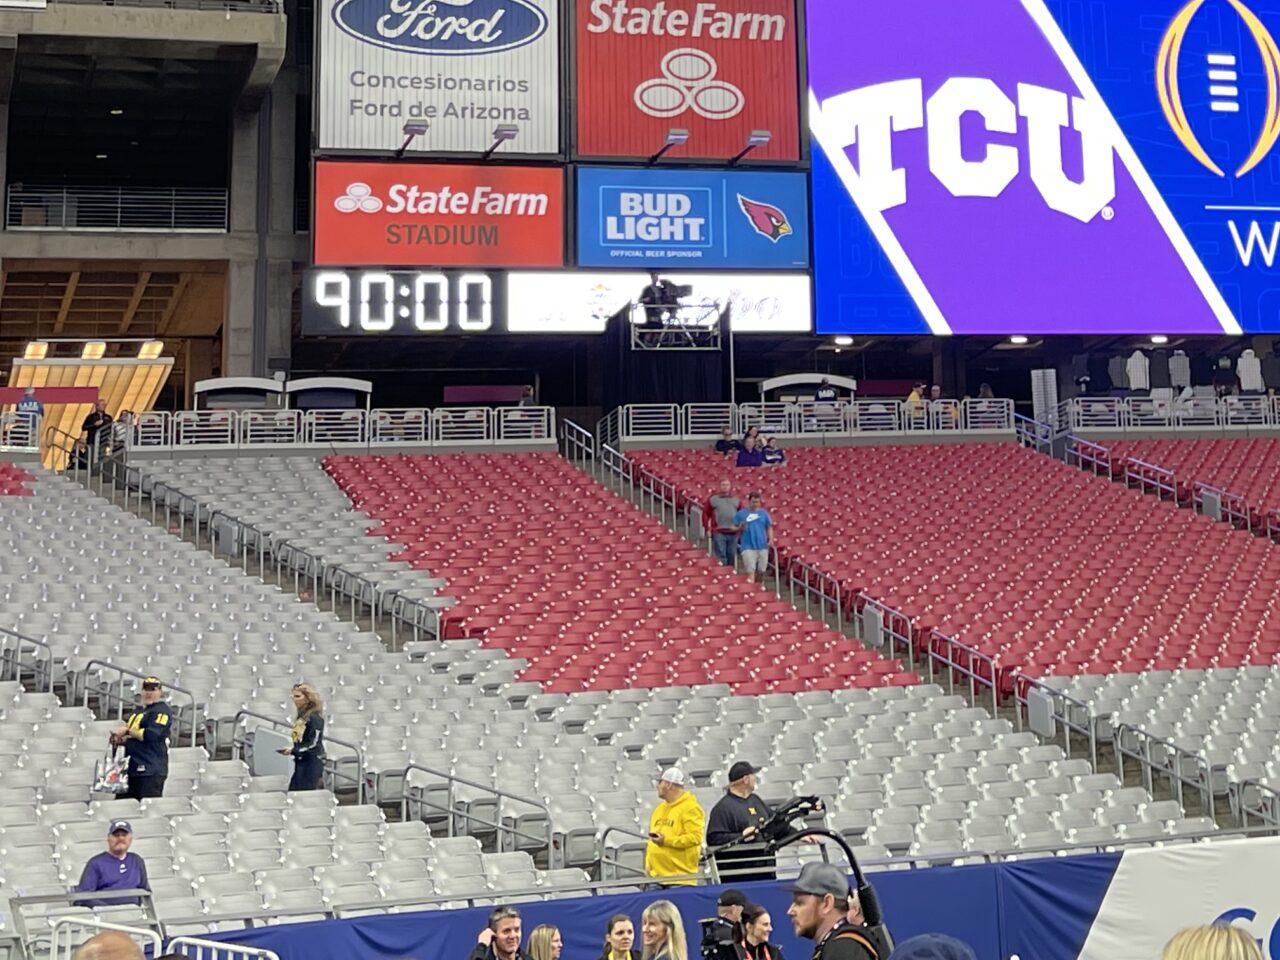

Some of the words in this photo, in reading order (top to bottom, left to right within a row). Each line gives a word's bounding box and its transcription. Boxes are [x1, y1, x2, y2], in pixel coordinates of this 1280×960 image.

[350, 70, 529, 92] Concesionarios
[350, 99, 402, 117] Ford
[408, 101, 437, 118] de
[443, 101, 531, 121] Arizona
[821, 77, 1116, 224] TCU
[620, 192, 692, 217] BUD
[385, 223, 499, 246] STADIUM
[606, 216, 705, 241] LIGHT
[610, 249, 644, 258] OFFICIAL
[645, 250, 666, 258] BEER
[315, 271, 493, 332] 90:00
